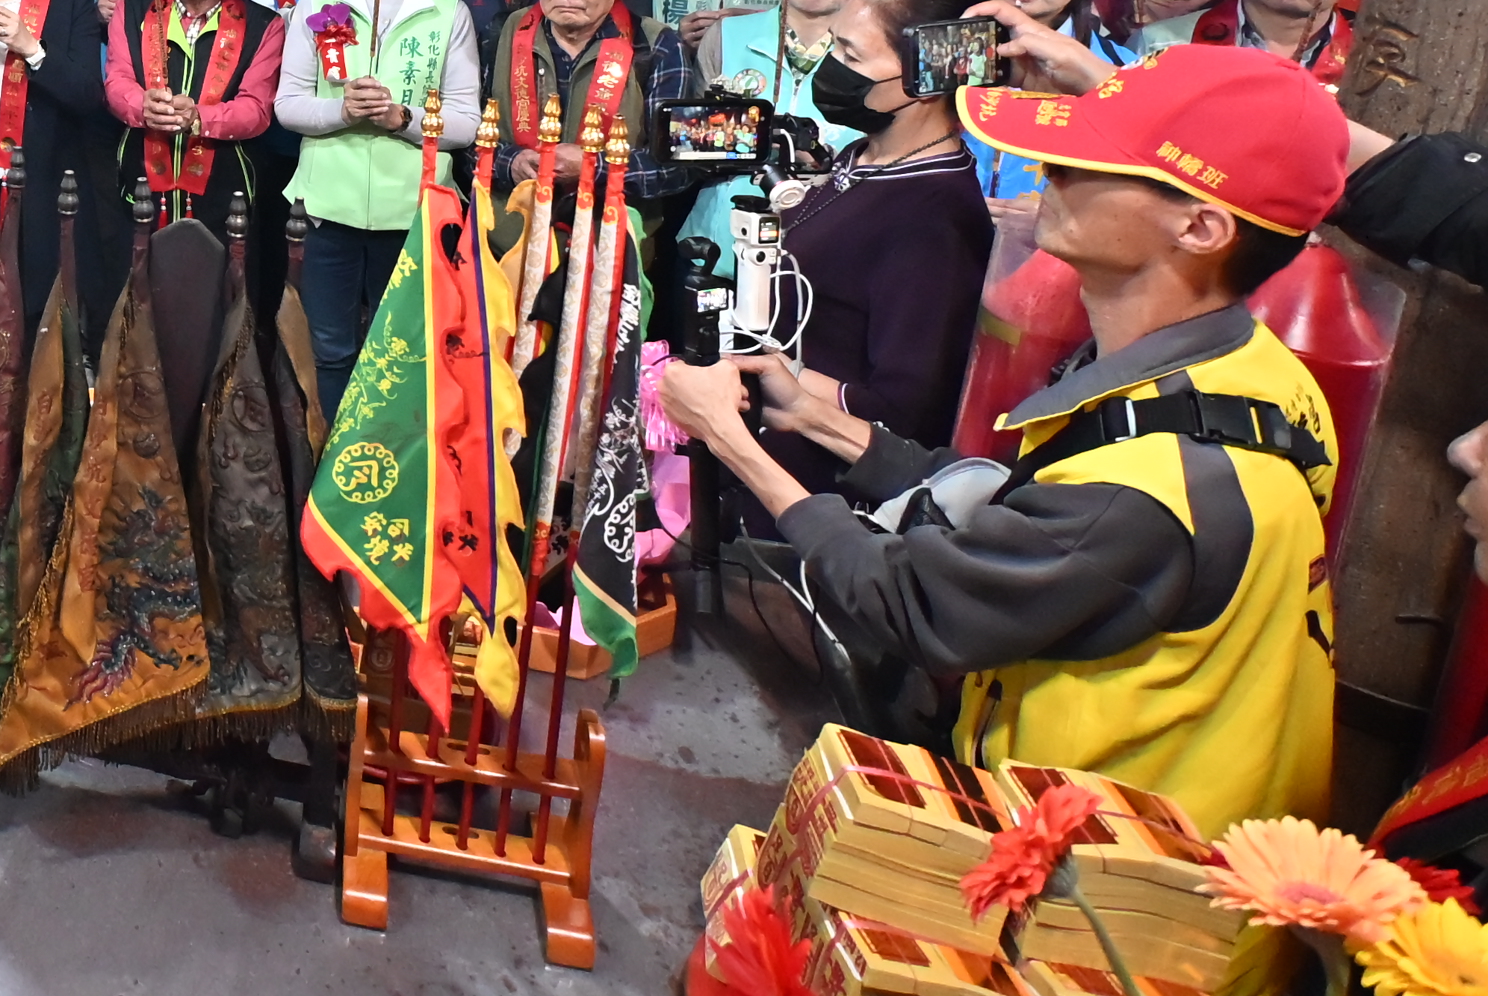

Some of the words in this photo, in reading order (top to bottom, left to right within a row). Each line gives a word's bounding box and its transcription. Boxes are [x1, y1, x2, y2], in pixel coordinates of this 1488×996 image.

[325, 47, 342, 81] 貴賓
[399, 36, 424, 105] 陳素月
[1155, 140, 1229, 190] 神轎班
